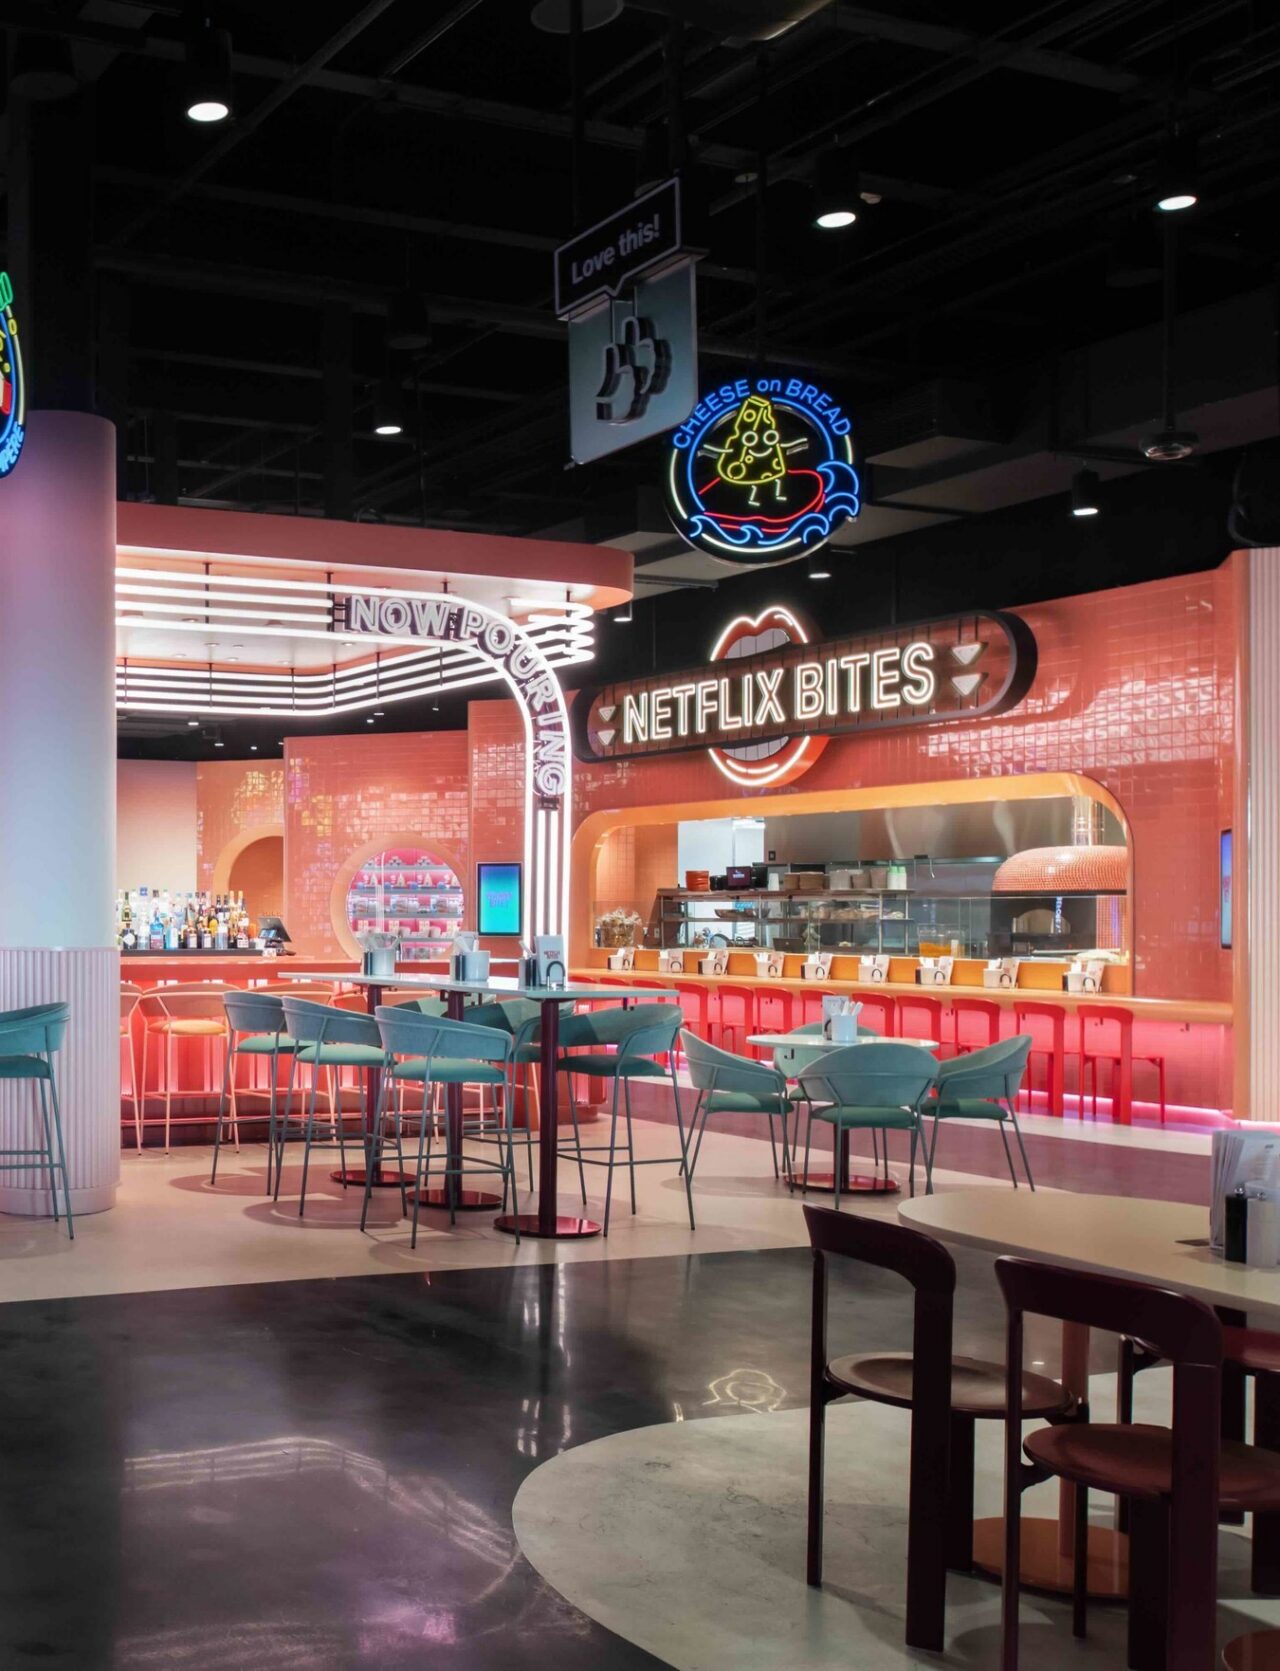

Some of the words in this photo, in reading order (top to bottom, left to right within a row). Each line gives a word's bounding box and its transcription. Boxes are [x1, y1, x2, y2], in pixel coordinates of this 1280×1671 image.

[571, 243, 615, 285] Love
[619, 213, 660, 255] this!
[672, 379, 750, 450] CHEESE
[757, 379, 781, 393] on
[785, 379, 852, 437] BREAD
[348, 594, 450, 637] NOW
[460, 606, 567, 796] POURING
[623, 667, 785, 743] NETFLIX
[795, 641, 935, 720] BITES
